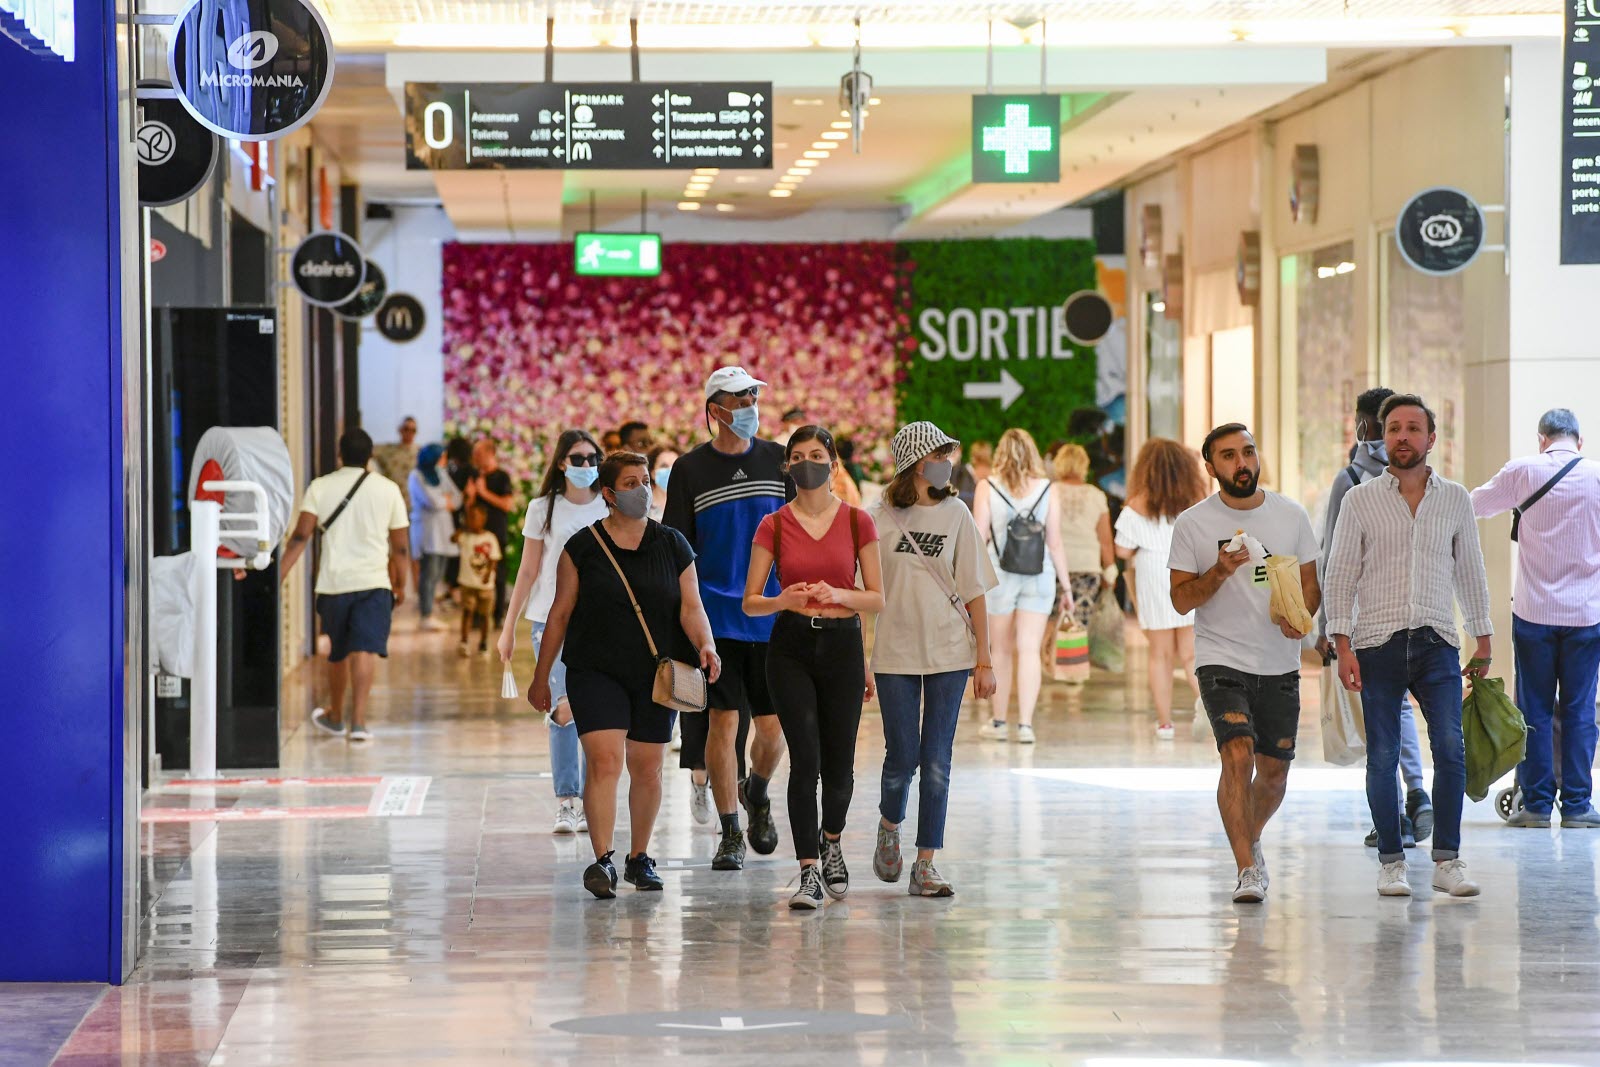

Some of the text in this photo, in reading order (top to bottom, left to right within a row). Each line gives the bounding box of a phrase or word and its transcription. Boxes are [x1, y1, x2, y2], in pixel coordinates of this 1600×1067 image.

[571, 94, 625, 106] PRIMARK
[471, 111, 520, 123] Ascenseurs
[670, 111, 717, 124] Transports
[423, 101, 454, 150] 0
[471, 128, 510, 140] Toilettes
[571, 129, 626, 140] MONOPRIX
[671, 128, 700, 140] Liaison
[471, 145, 549, 158] Direction du centre
[671, 145, 695, 157] Porte
[1571, 157, 1594, 170] gare
[1571, 187, 1600, 200] porte
[1571, 202, 1600, 215] porte
[299, 260, 355, 277] claire's
[918, 305, 1074, 362] SORTIE
